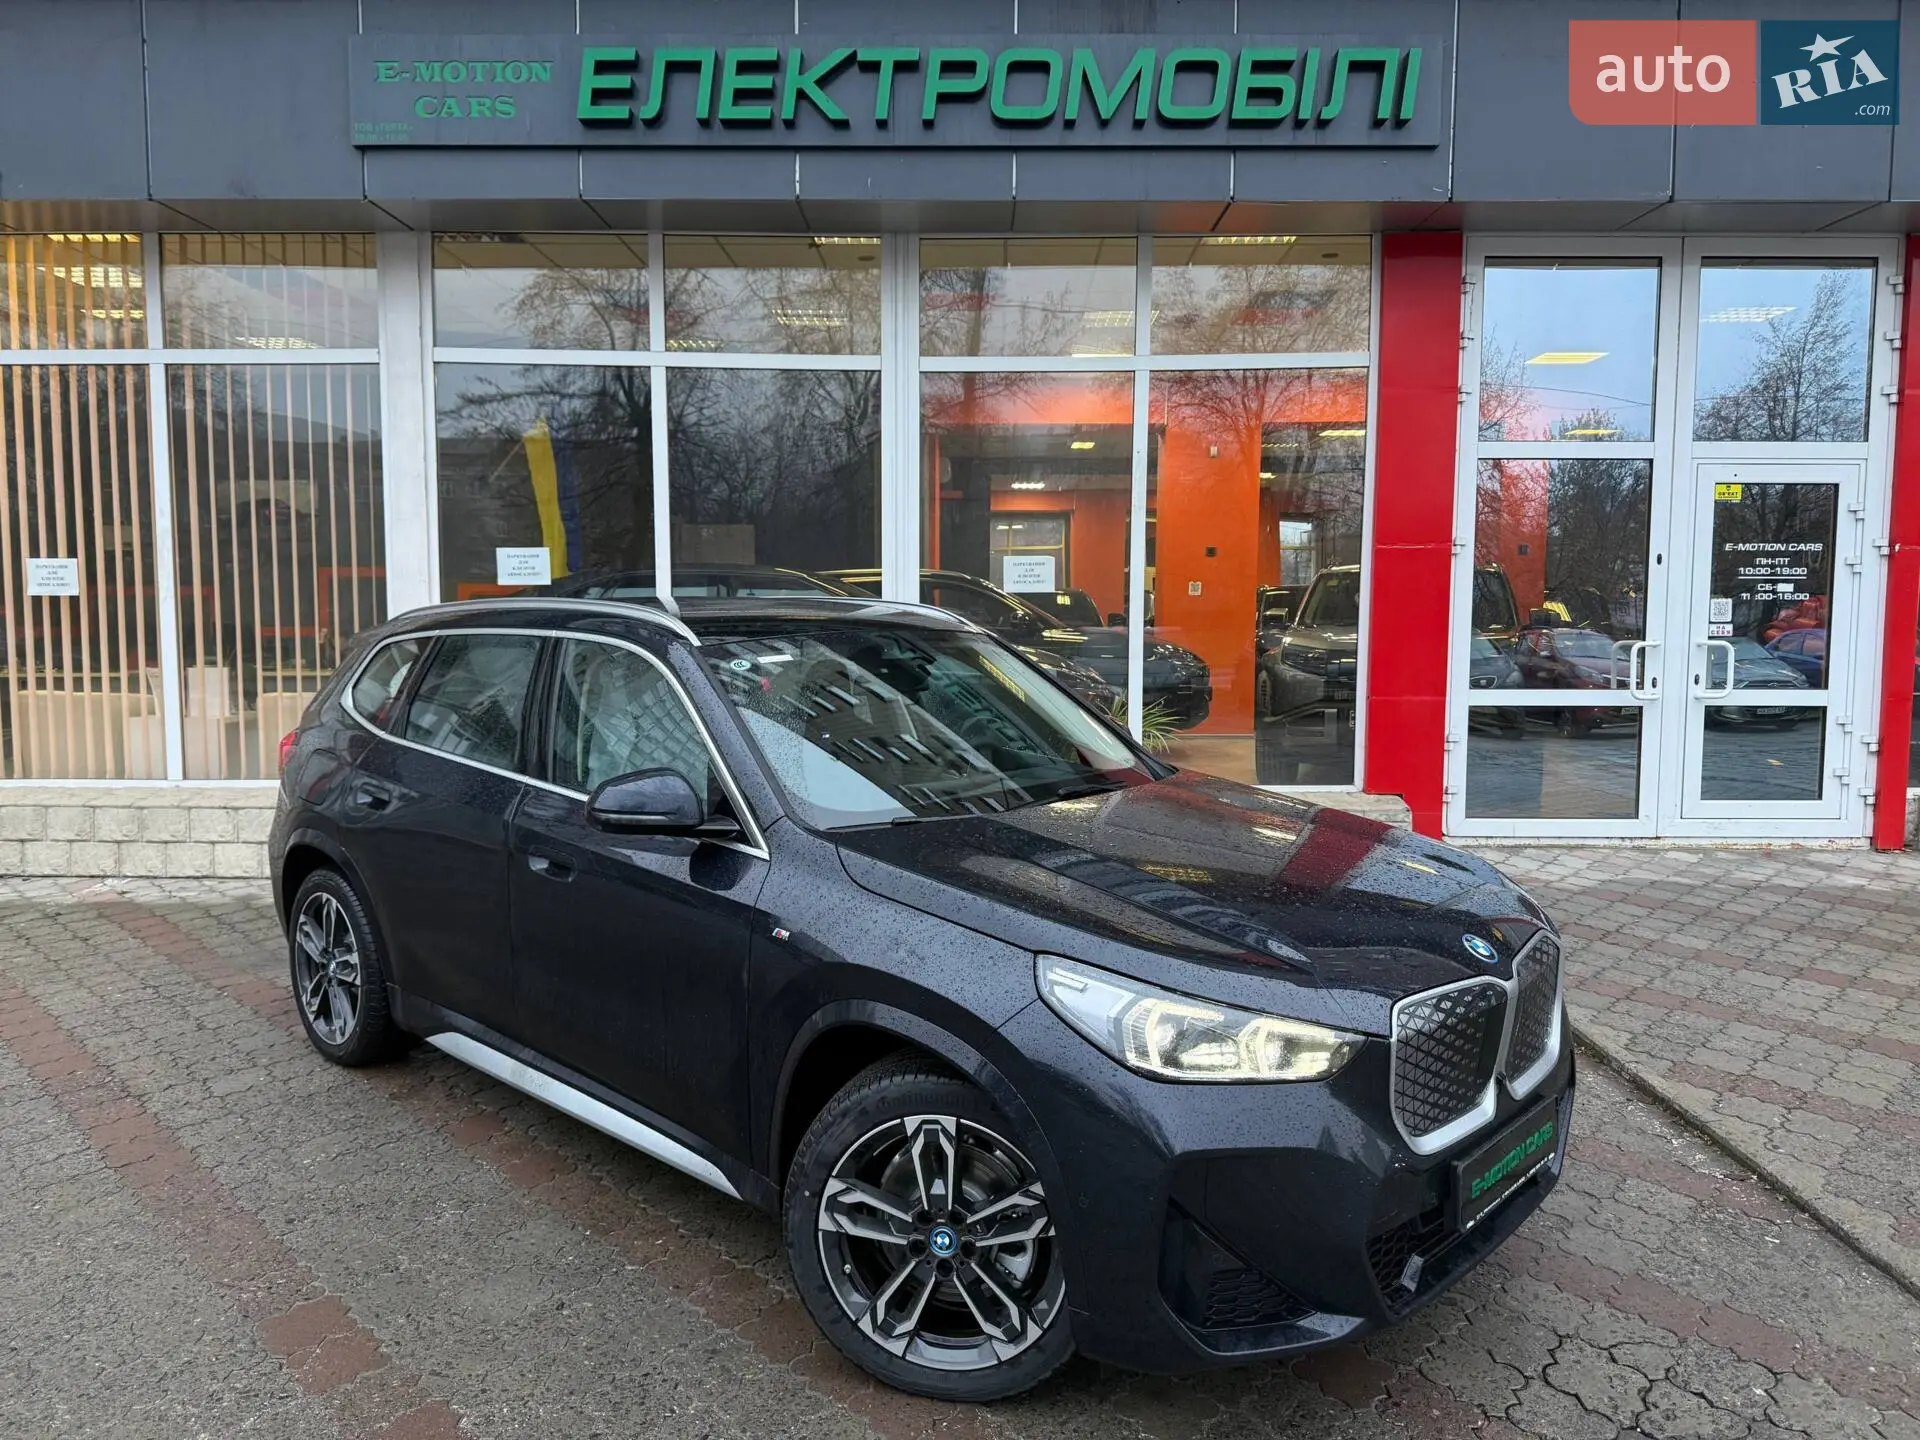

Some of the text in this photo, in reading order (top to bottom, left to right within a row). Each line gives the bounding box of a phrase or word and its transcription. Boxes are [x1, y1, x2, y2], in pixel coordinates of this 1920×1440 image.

[374, 60, 554, 84] E-MOTION
[576, 46, 1423, 123] ЕЛЕКТРОМОБІЛІ
[414, 95, 517, 119] CARS
[1724, 543, 1823, 551] E-MOTION CARS
[1755, 557, 1791, 565] ПН-ПТ
[1738, 567, 1807, 575] 10:00-19:00
